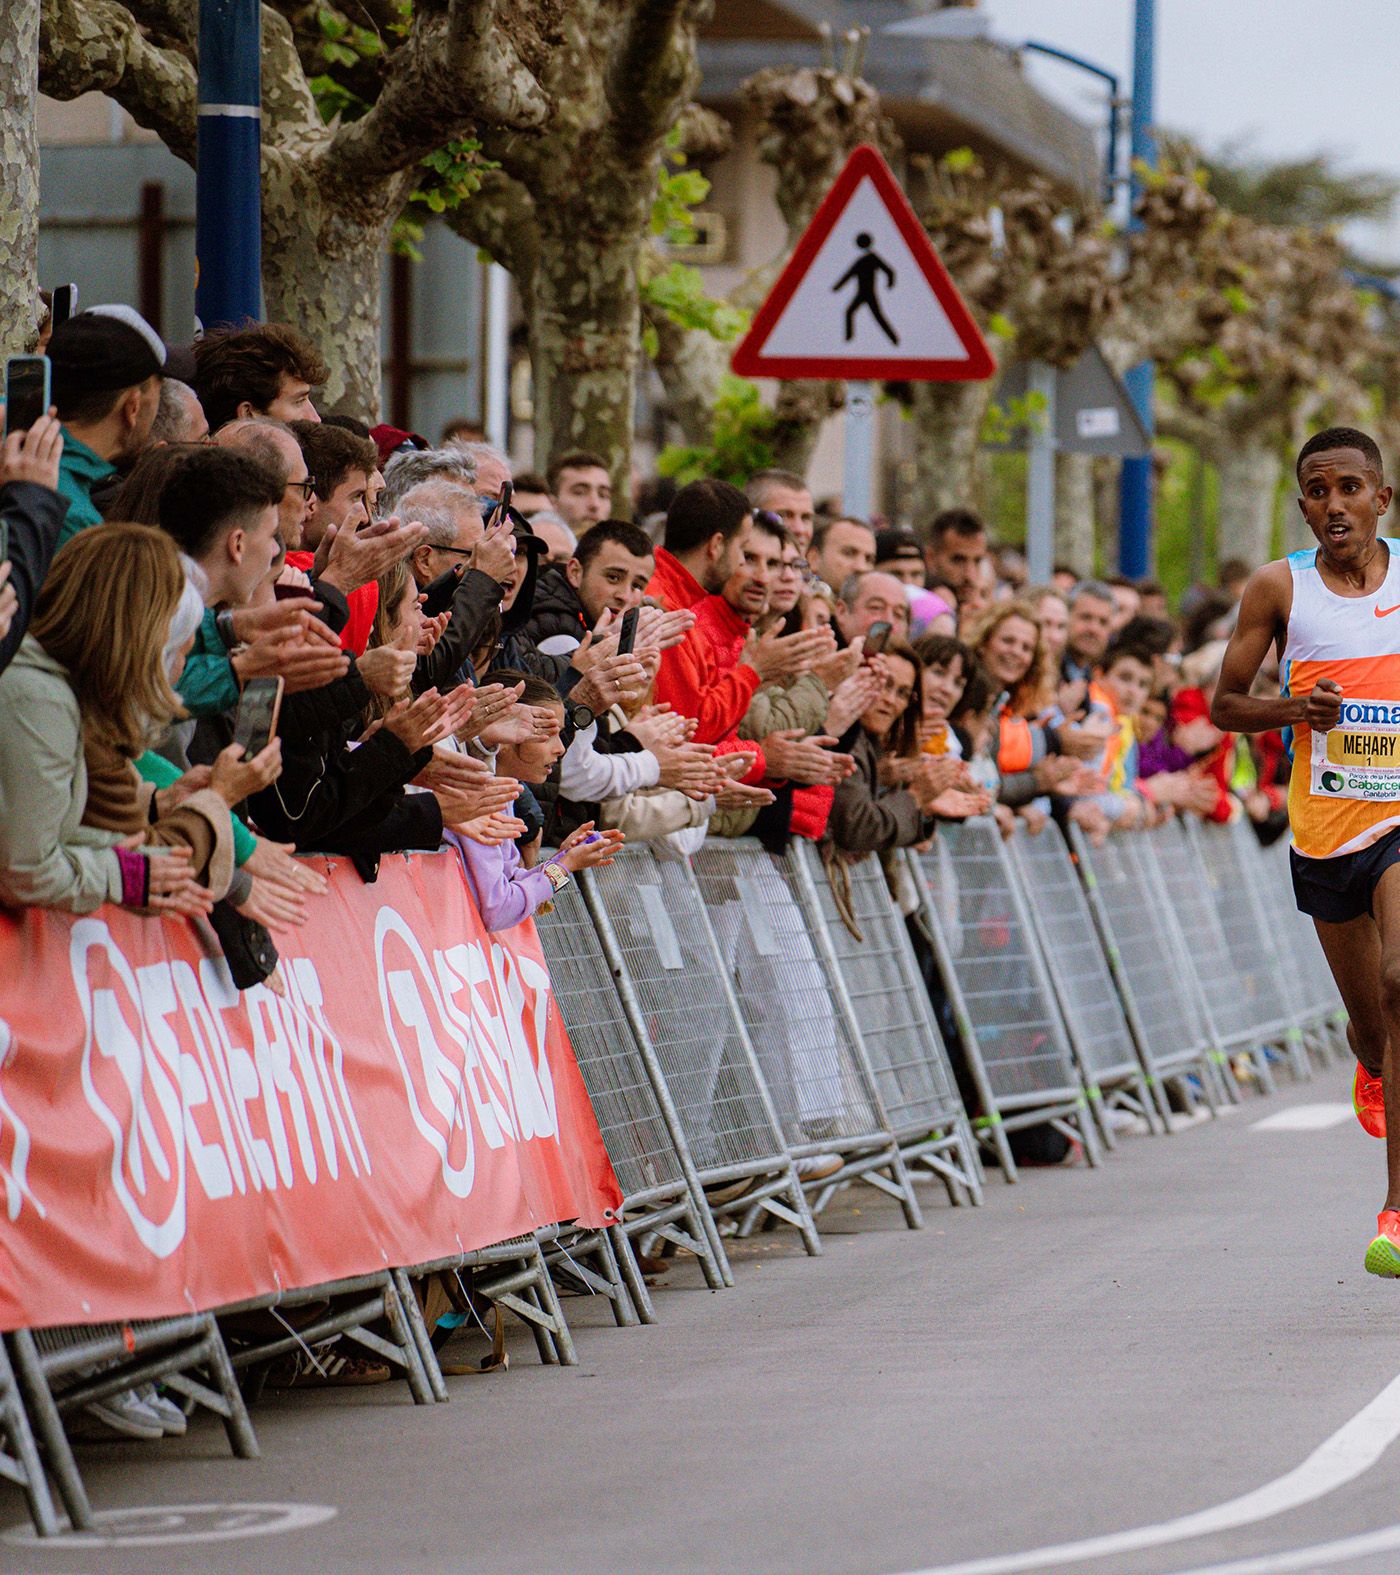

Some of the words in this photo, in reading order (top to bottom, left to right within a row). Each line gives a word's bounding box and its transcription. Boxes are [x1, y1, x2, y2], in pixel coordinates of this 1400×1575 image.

[1343, 734, 1397, 757] MEHARY
[1366, 757, 1372, 767] 1
[1349, 772, 1369, 780] Parque
[1363, 790, 1397, 799] Cantabria
